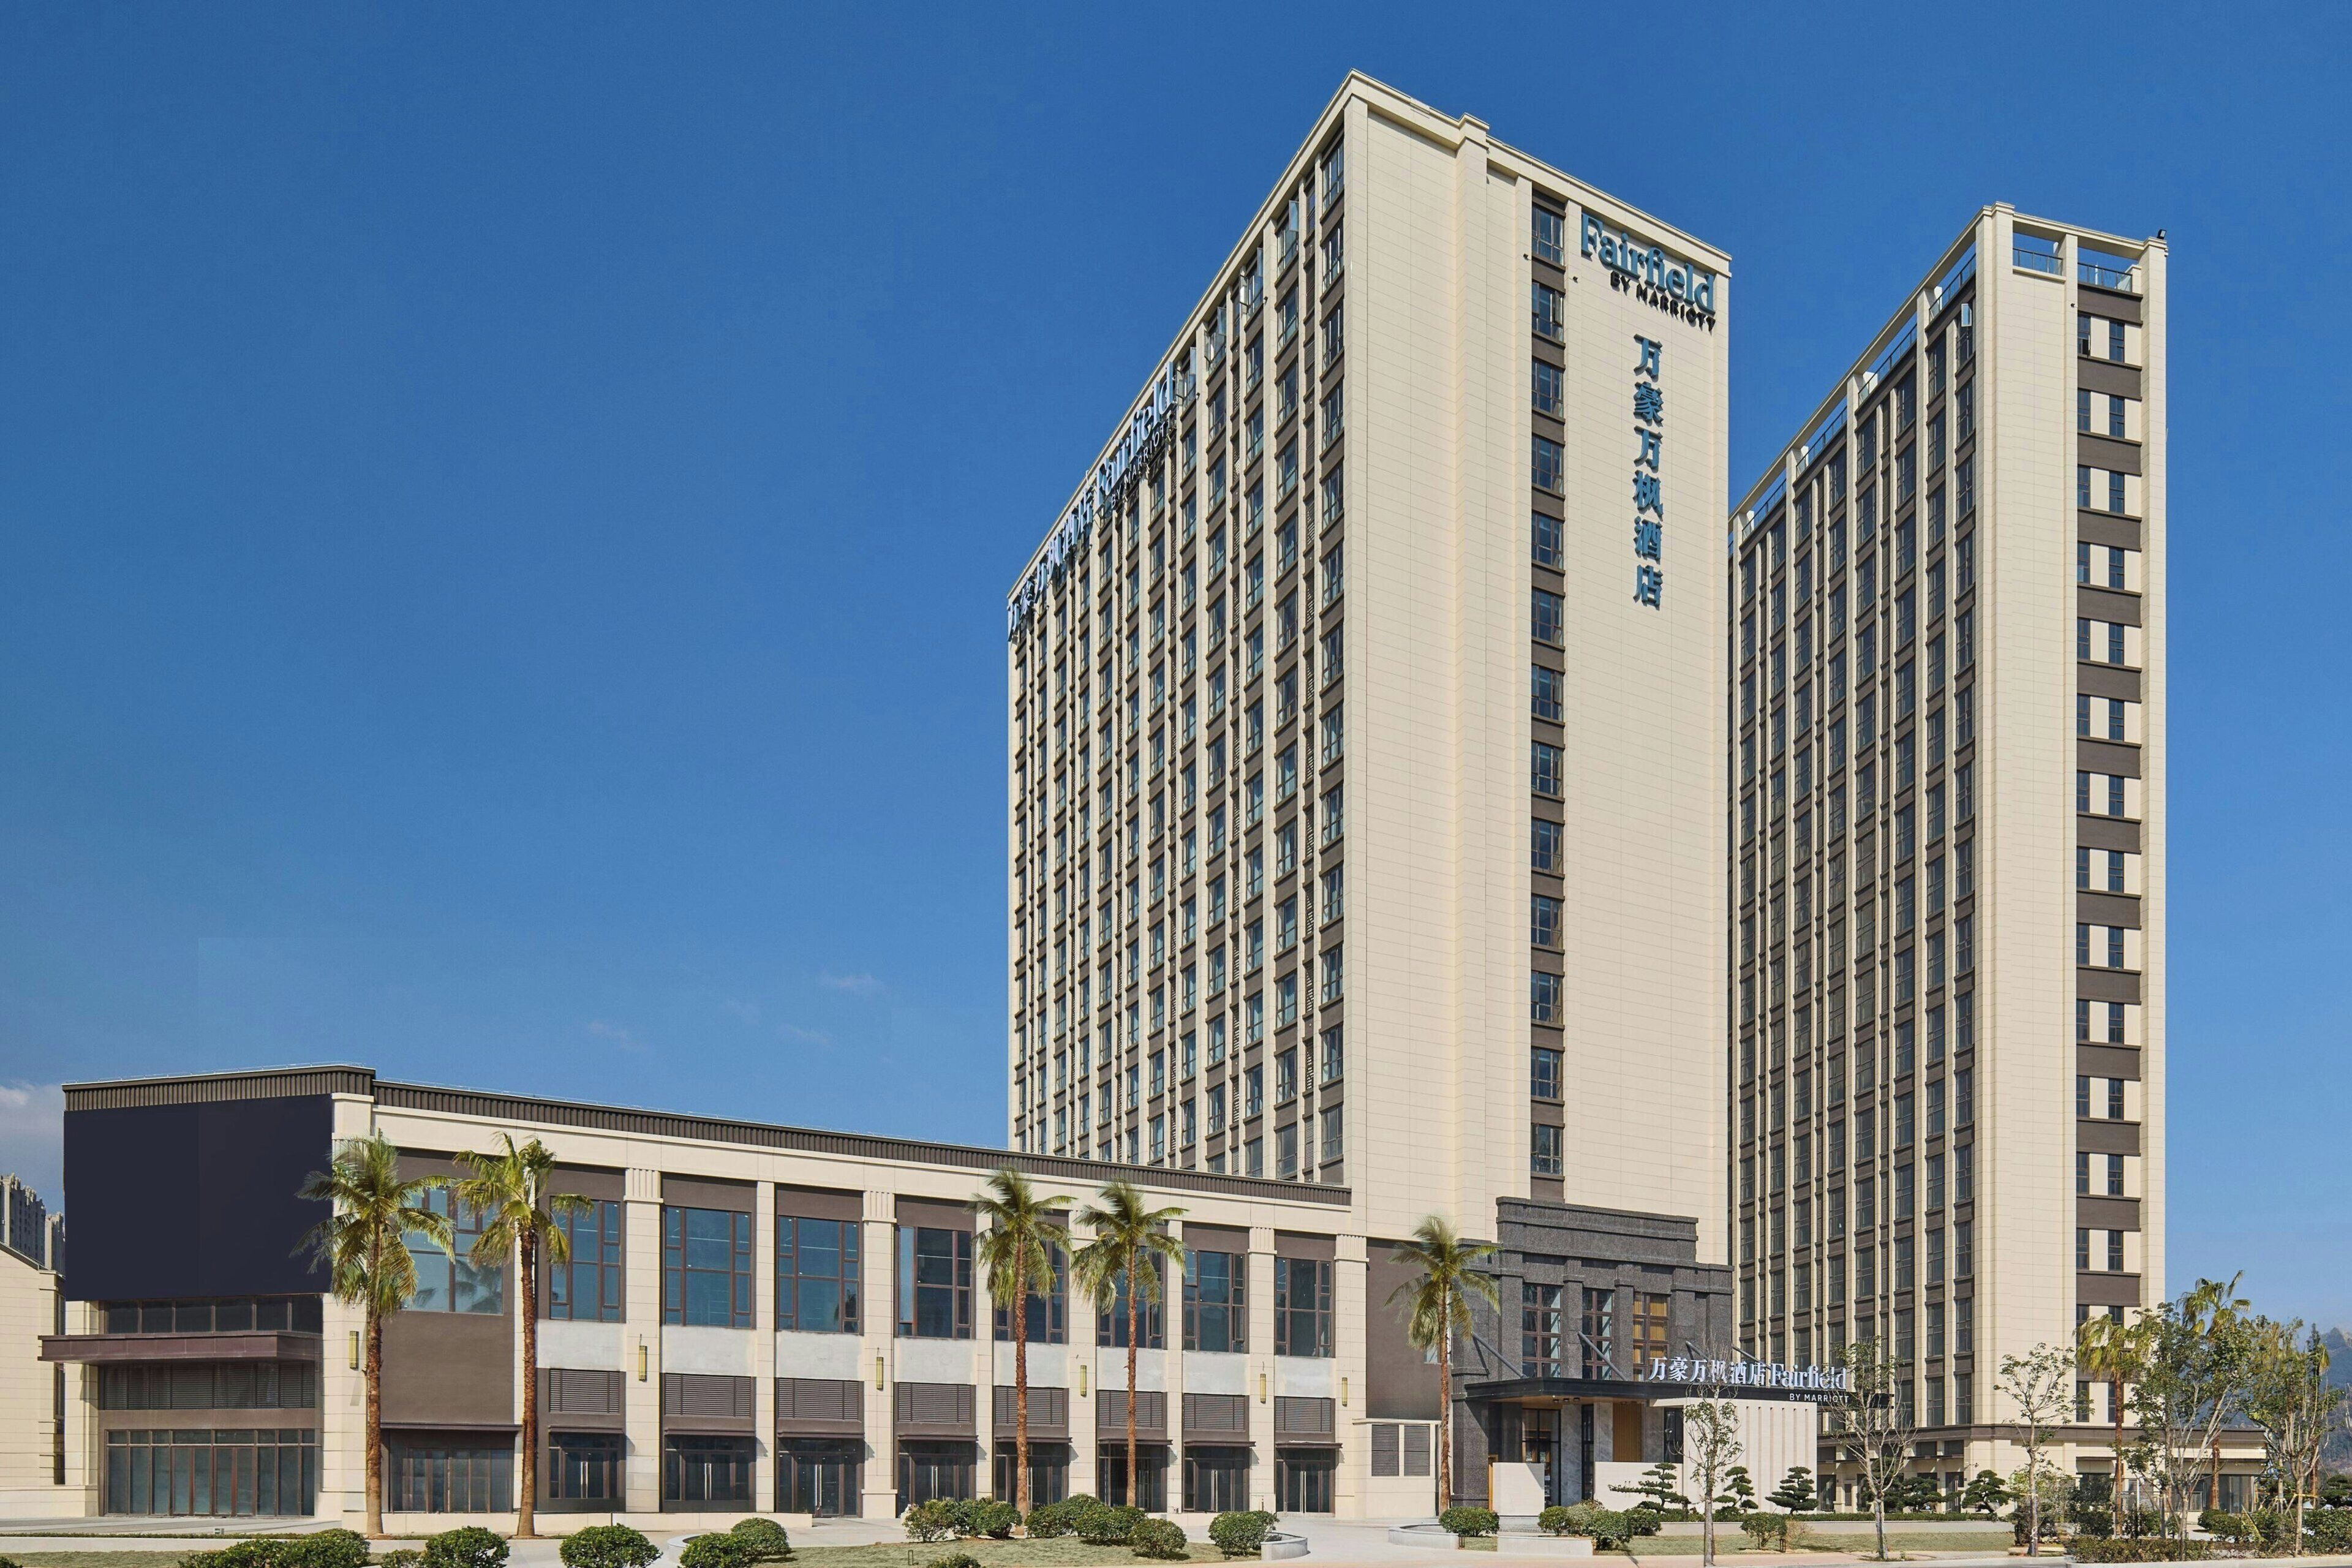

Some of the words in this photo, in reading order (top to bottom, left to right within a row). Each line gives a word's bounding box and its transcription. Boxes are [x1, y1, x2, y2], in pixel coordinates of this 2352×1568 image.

[1581, 212, 1716, 316] Fairfield
[1610, 270, 1630, 293] BY
[1636, 283, 1716, 333] MARRIOTT
[1096, 361, 1173, 508] Fairfield
[1111, 484, 1121, 509] BY
[1124, 410, 1171, 484] MARRIOTT
[1634, 334, 1663, 609] 万豪万枫酒店
[1646, 1355, 1766, 1386] 万豪万枫酒店
[1770, 1363, 1847, 1390] Fairfield
[1804, 1393, 1849, 1403] MARRIOTT
